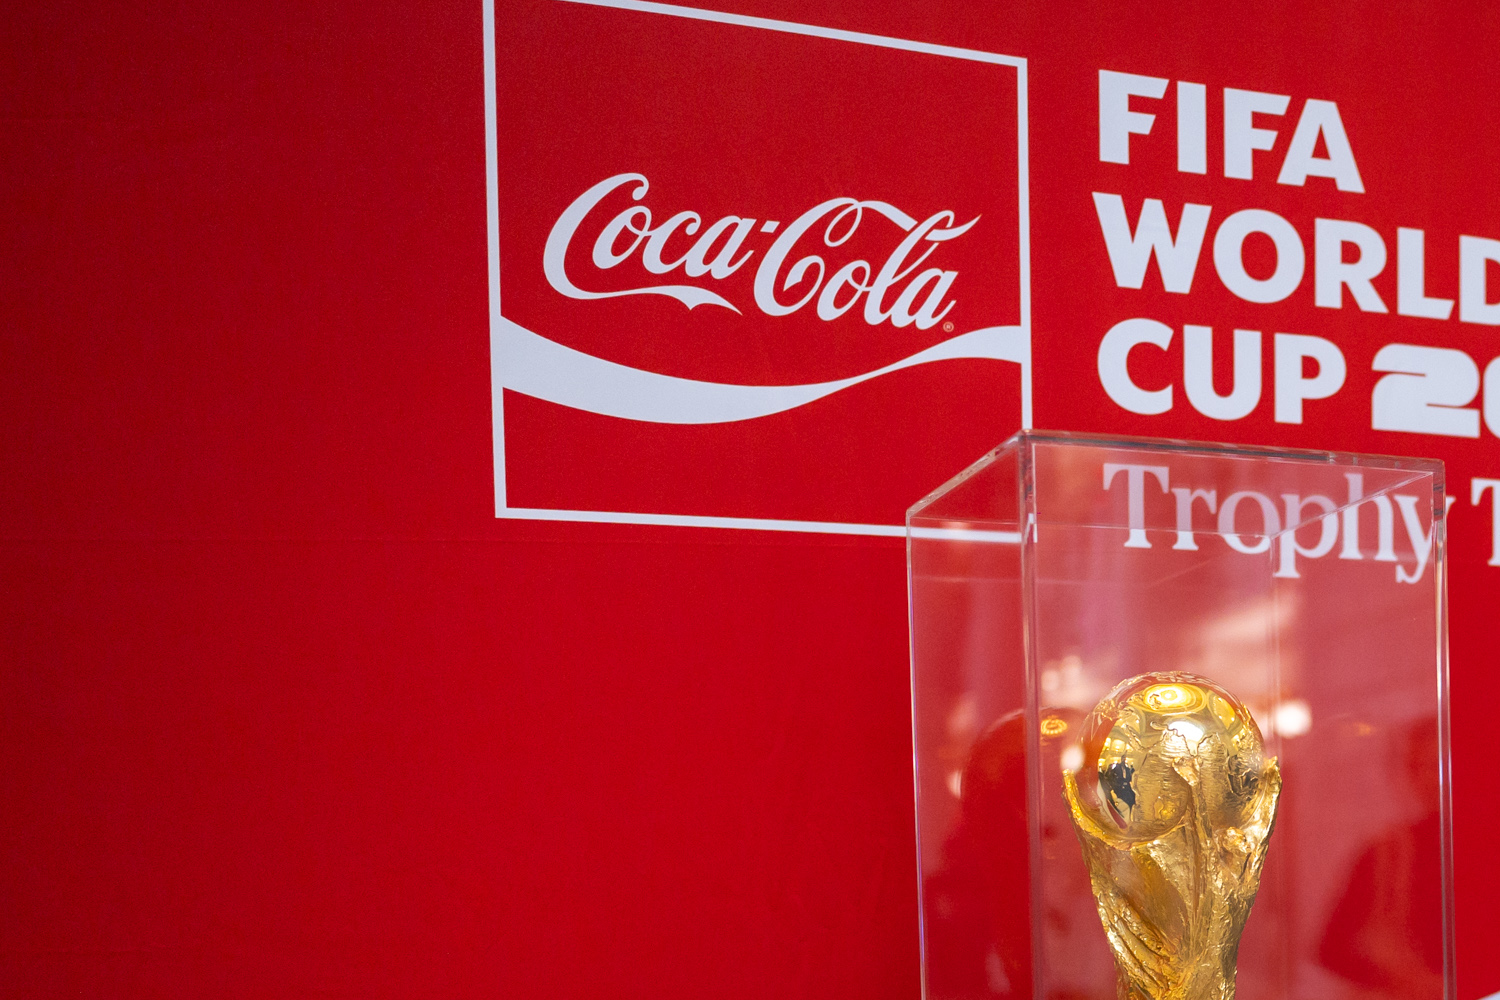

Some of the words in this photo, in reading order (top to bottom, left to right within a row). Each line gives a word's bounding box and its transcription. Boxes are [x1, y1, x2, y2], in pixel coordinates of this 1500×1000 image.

[1098, 69, 1365, 194] FIFA
[543, 172, 981, 331] Coca-Cola
[1097, 318, 1347, 425] CUP
[1102, 462, 1455, 584] Trophy
